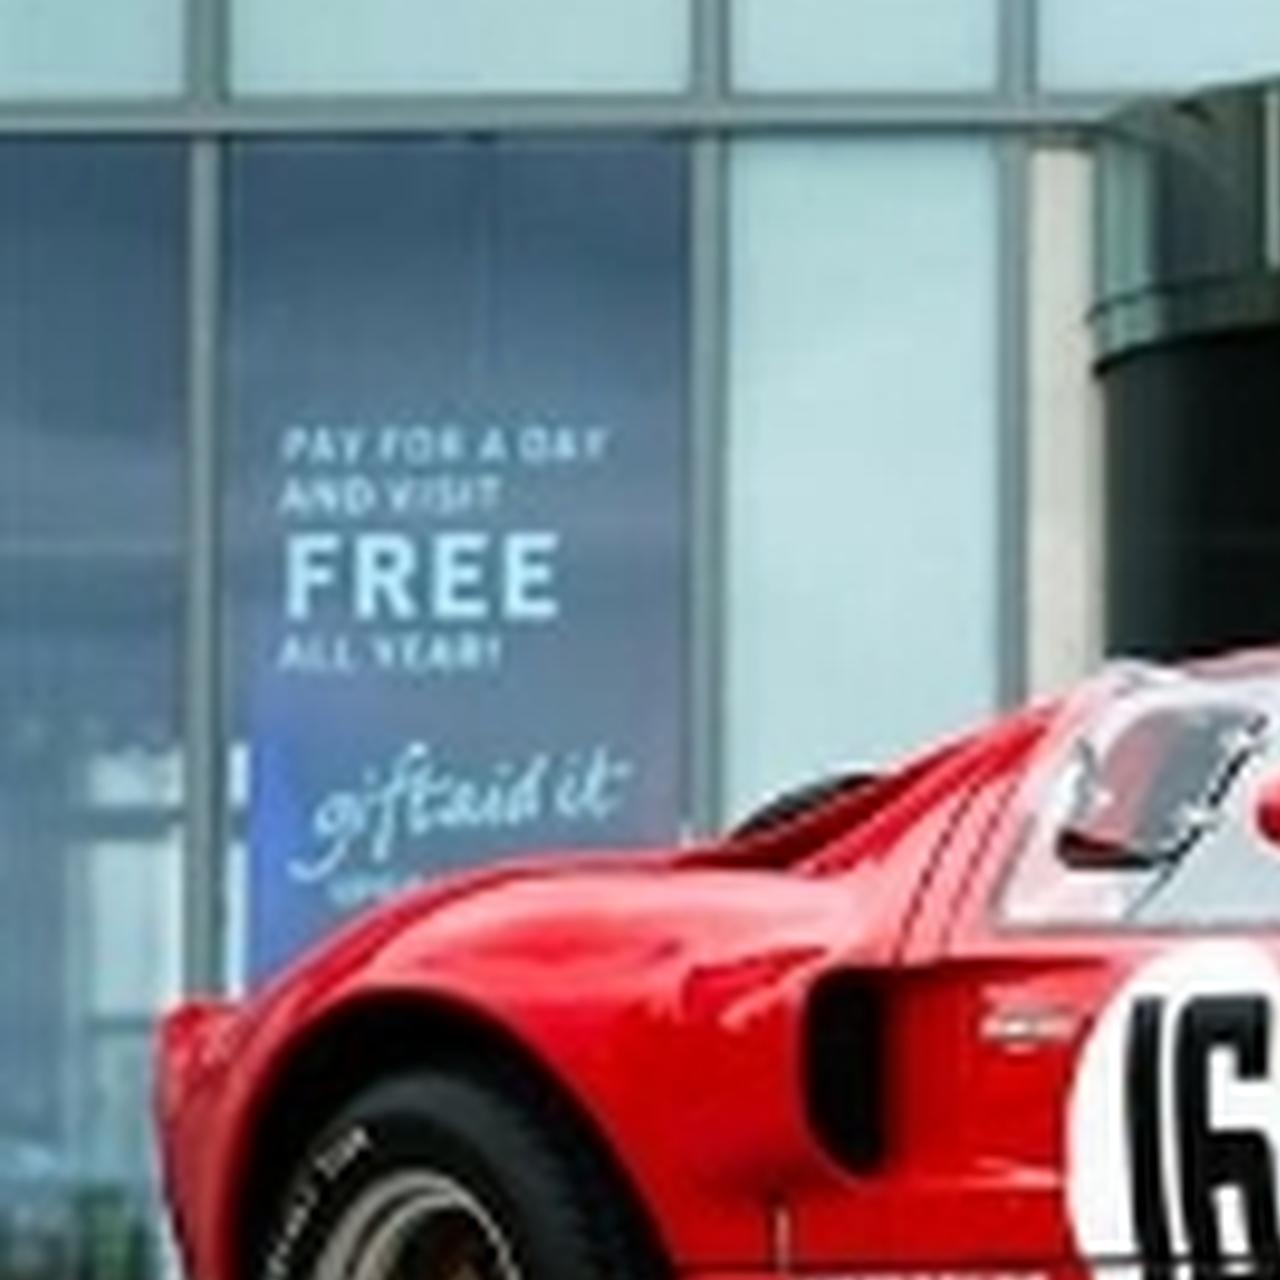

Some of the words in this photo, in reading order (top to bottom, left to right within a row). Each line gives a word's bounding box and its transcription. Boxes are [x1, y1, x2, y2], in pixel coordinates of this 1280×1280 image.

[280, 424, 366, 464] PAY
[478, 424, 508, 464] A
[518, 424, 610, 464] DAY
[277, 476, 377, 516] AND
[386, 474, 501, 515] VISIT
[285, 532, 560, 620] FREE
[278, 634, 356, 672] ALL
